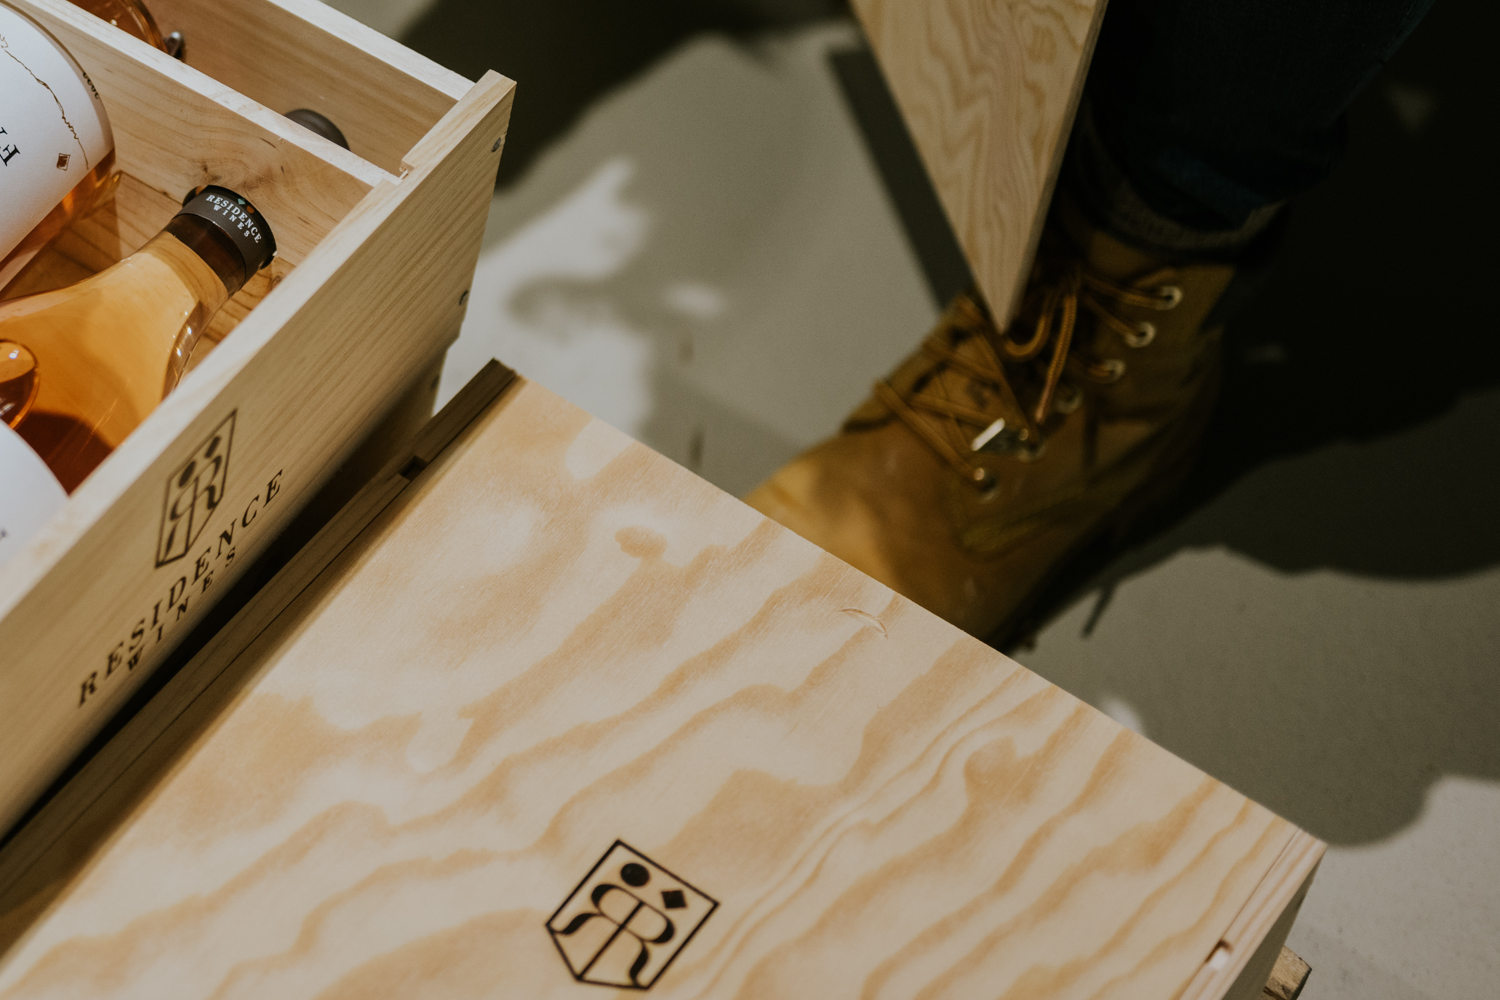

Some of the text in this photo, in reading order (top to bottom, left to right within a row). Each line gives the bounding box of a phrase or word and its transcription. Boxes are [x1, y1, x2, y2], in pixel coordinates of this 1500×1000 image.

[205, 194, 262, 244] RESIDENCE
[213, 204, 250, 238] WINES
[78, 468, 284, 709] RESIDENCE
[127, 546, 236, 671] WINES
